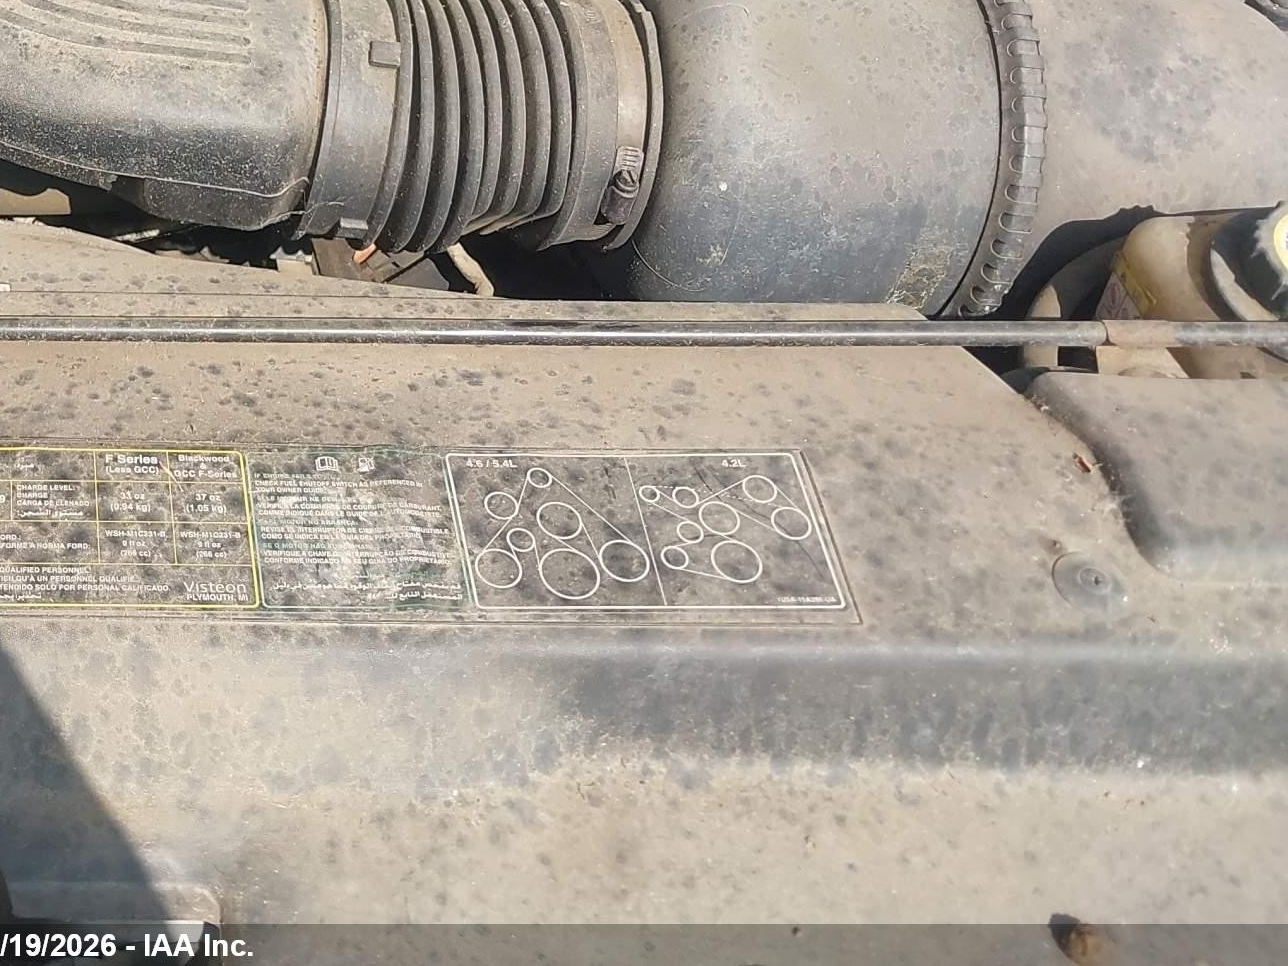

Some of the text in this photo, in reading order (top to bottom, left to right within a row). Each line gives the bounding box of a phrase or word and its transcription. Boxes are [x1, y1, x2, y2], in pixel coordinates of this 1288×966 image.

[105, 454, 158, 464] F Series
[177, 454, 230, 462] Blackwood
[466, 459, 484, 468] 4.6
[491, 459, 518, 468] 5.4L
[721, 458, 747, 468] 4.2L
[133, 465, 160, 474] GCC)
[173, 470, 196, 478] GCC
[183, 579, 247, 593] Visteon
[238, 593, 249, 602] MI
